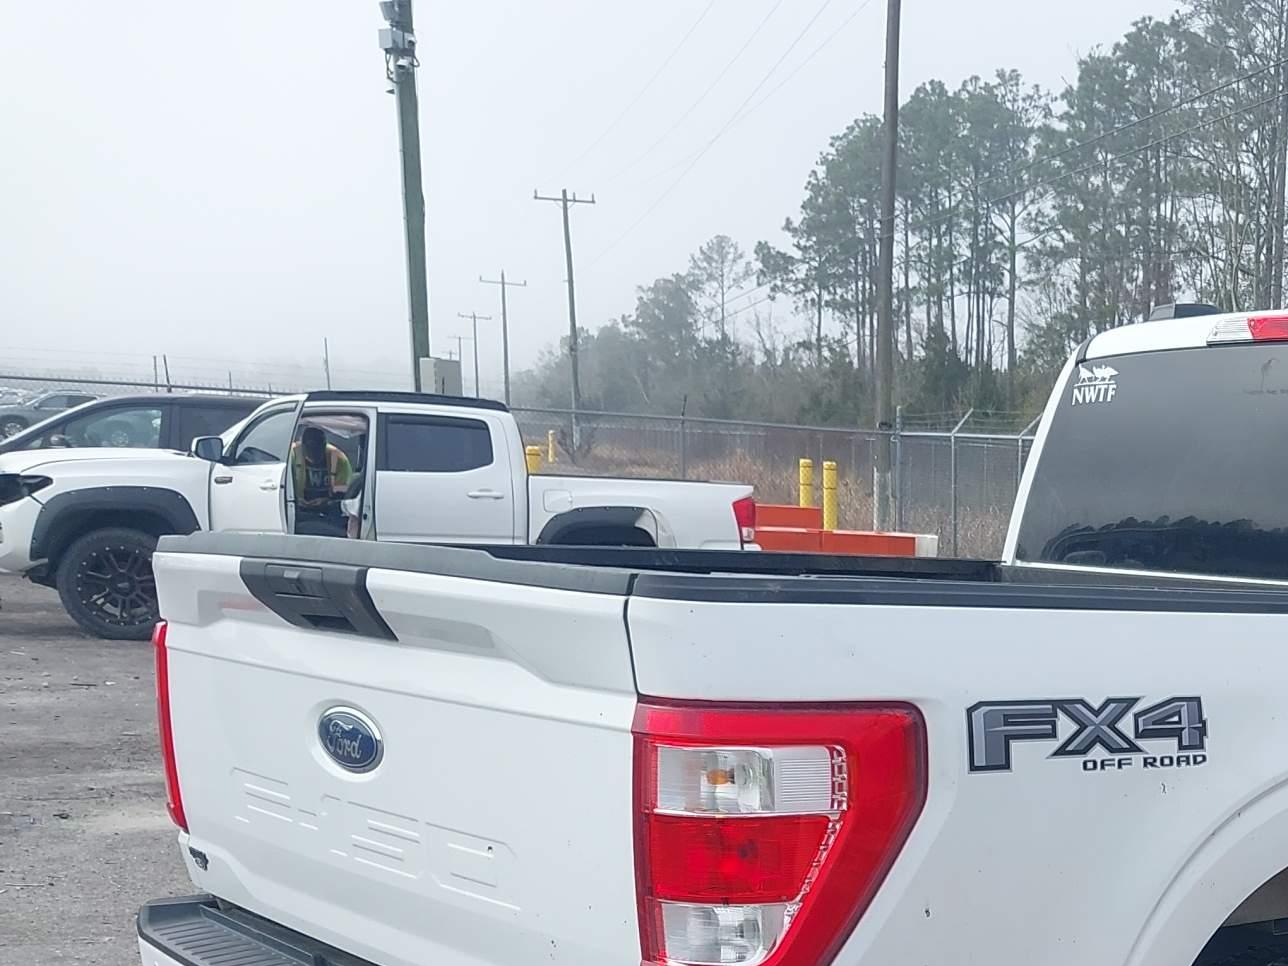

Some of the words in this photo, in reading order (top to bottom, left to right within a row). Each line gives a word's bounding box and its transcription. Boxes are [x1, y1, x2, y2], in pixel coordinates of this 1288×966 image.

[1072, 385, 1117, 406] NWTF
[326, 719, 363, 759] Ford
[967, 696, 1207, 771] FX4
[1082, 757, 1133, 771] OFF
[1143, 754, 1207, 769] ROAD
